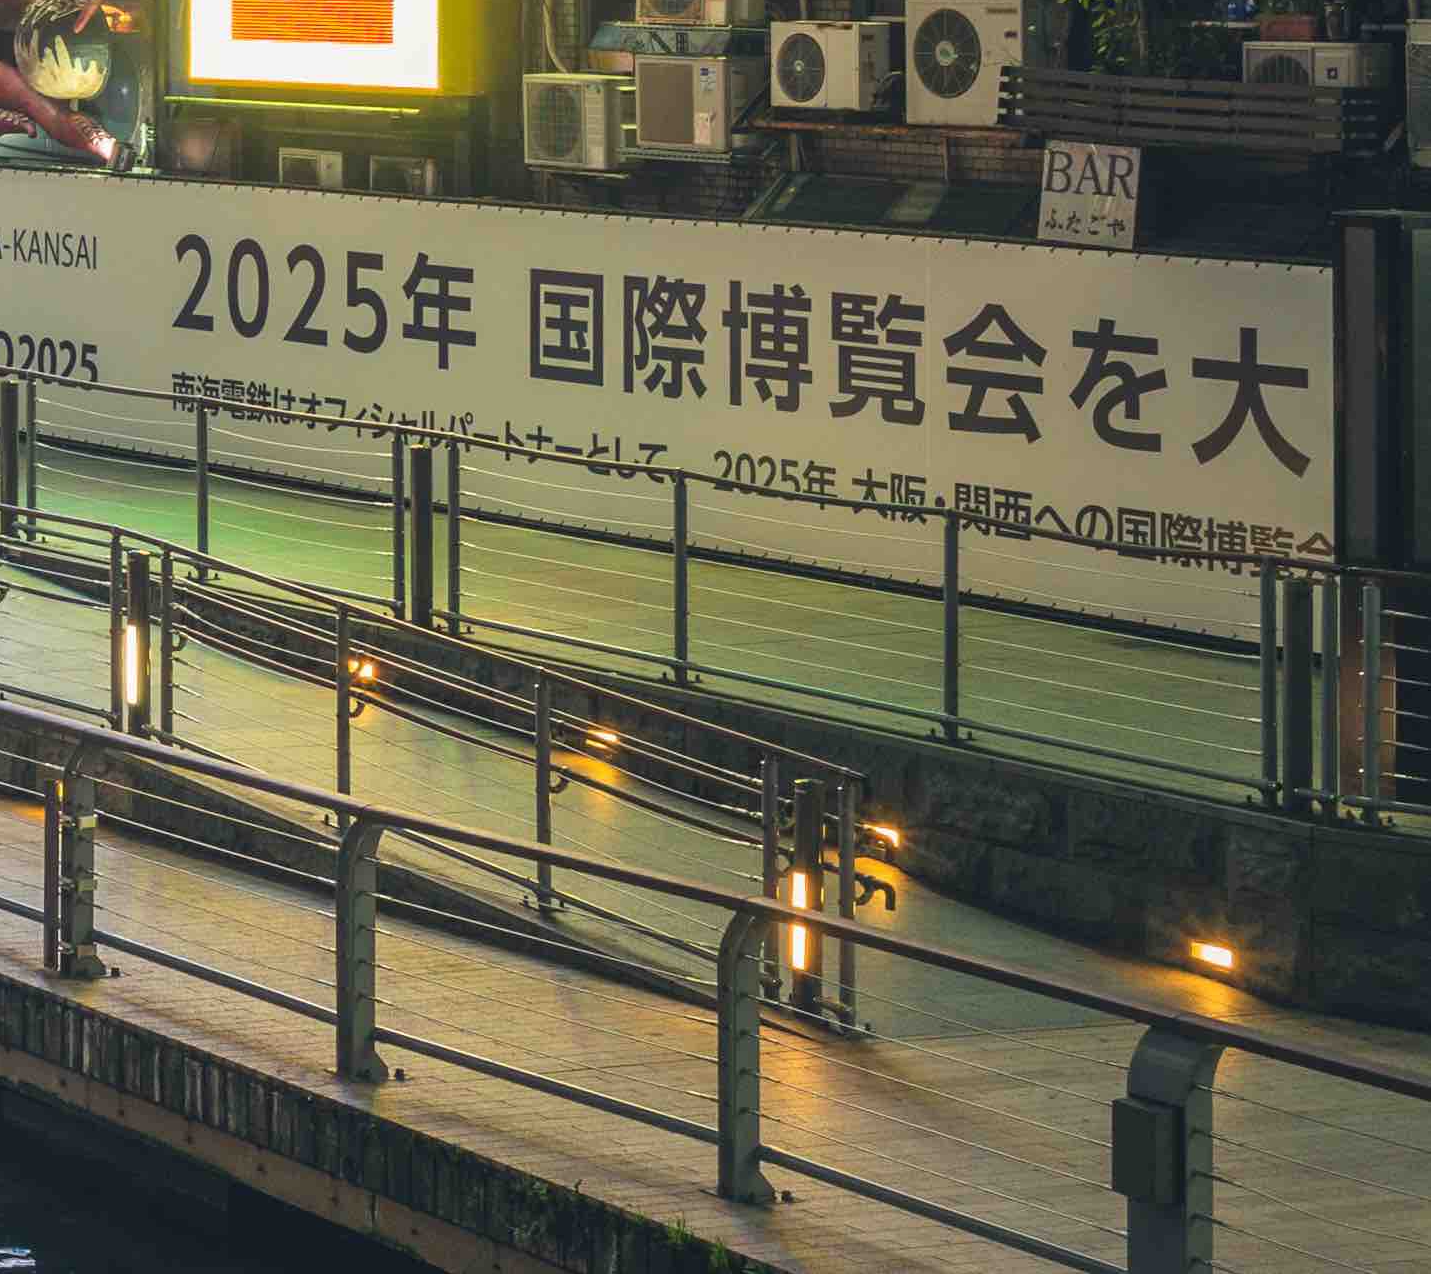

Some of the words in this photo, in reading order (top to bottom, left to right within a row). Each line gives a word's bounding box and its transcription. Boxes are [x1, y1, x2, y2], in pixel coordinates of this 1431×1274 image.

[1041, 150, 1135, 200] BAR
[173, 233, 478, 371] 2025年
[529, 267, 1312, 479] 国際博覧会を大
